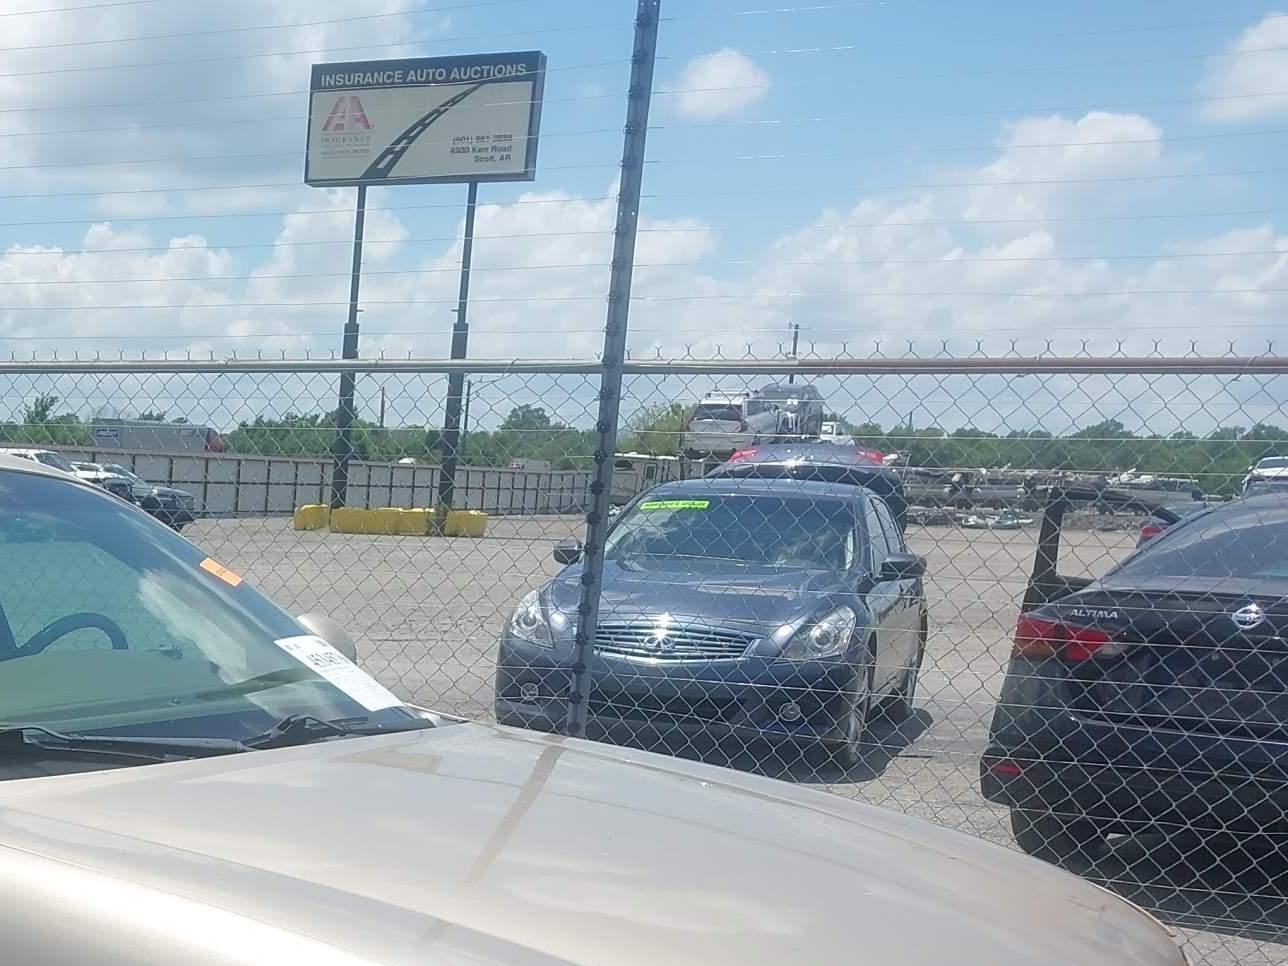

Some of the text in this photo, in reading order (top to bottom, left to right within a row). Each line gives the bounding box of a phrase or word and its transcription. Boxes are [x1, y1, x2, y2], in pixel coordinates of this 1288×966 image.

[321, 63, 527, 87] INSURANCE AUTO AUCTIONS
[1070, 608, 1118, 619] ALTIMA
